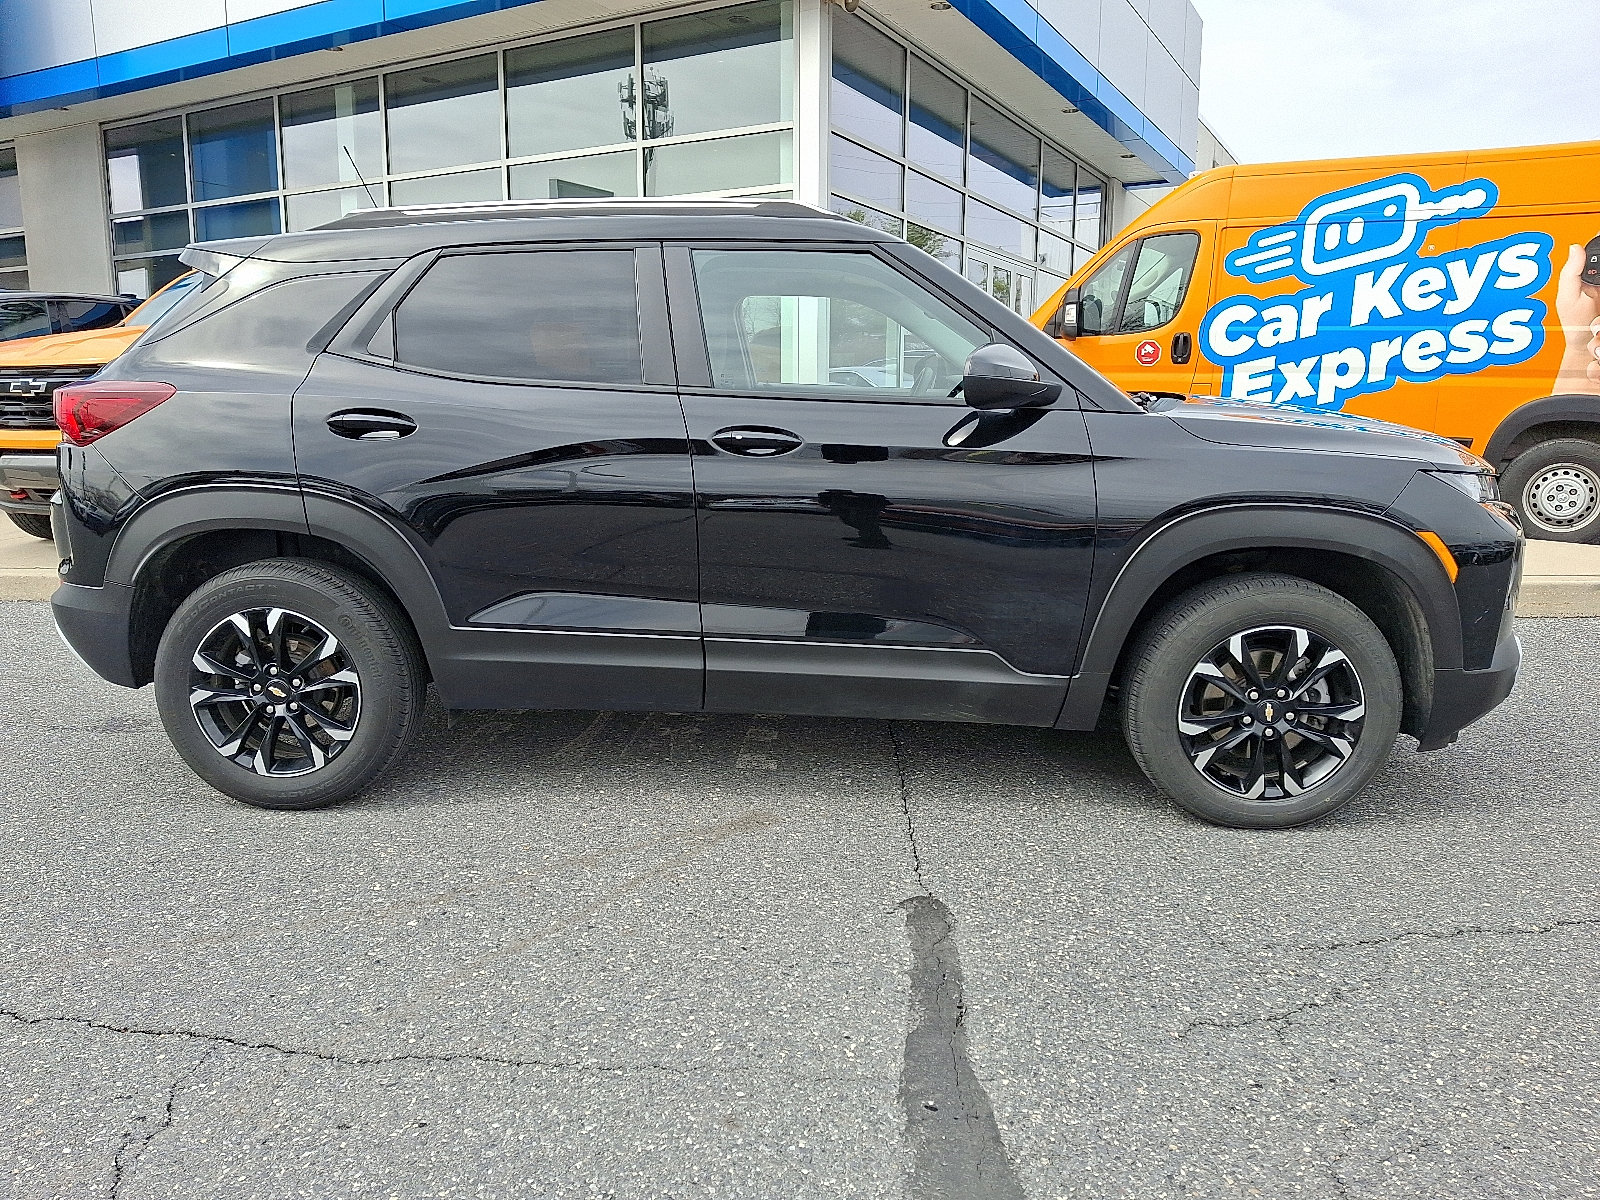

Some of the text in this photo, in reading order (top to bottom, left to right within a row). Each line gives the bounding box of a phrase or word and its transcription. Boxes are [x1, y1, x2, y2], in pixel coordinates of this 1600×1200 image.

[1208, 243, 1541, 358] Car Keys
[1231, 308, 1535, 405] Express
